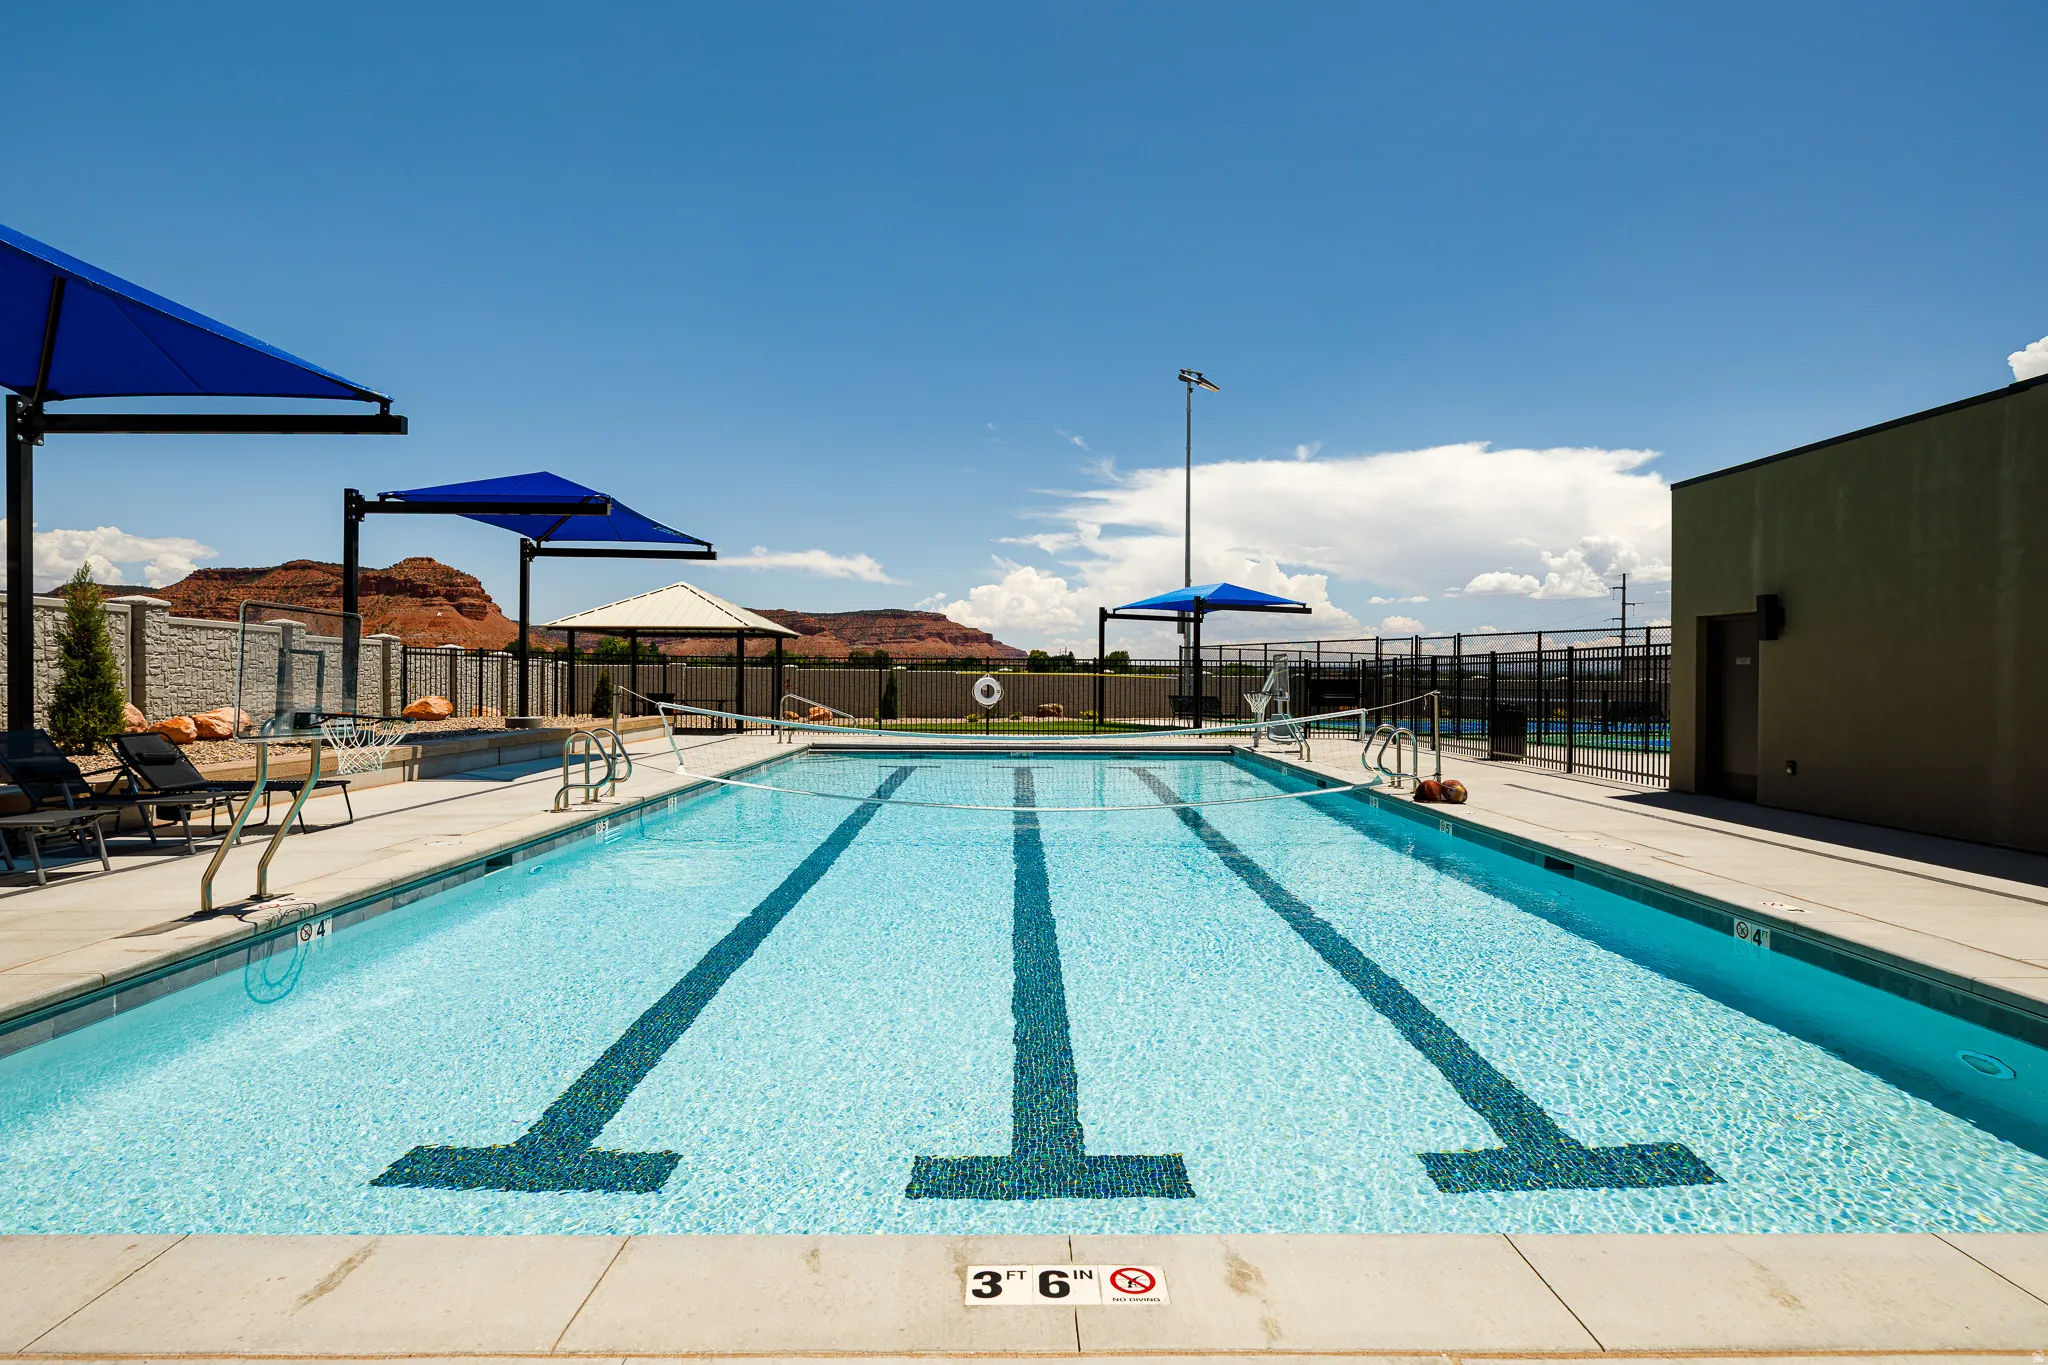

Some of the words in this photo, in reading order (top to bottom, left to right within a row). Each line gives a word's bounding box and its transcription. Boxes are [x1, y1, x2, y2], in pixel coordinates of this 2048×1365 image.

[316, 919, 326, 936] 4
[1753, 929, 1762, 946] 4
[971, 1270, 1003, 1299] 3
[1006, 1270, 1027, 1280] FT
[1038, 1270, 1071, 1299] 6
[1073, 1269, 1093, 1280] IN
